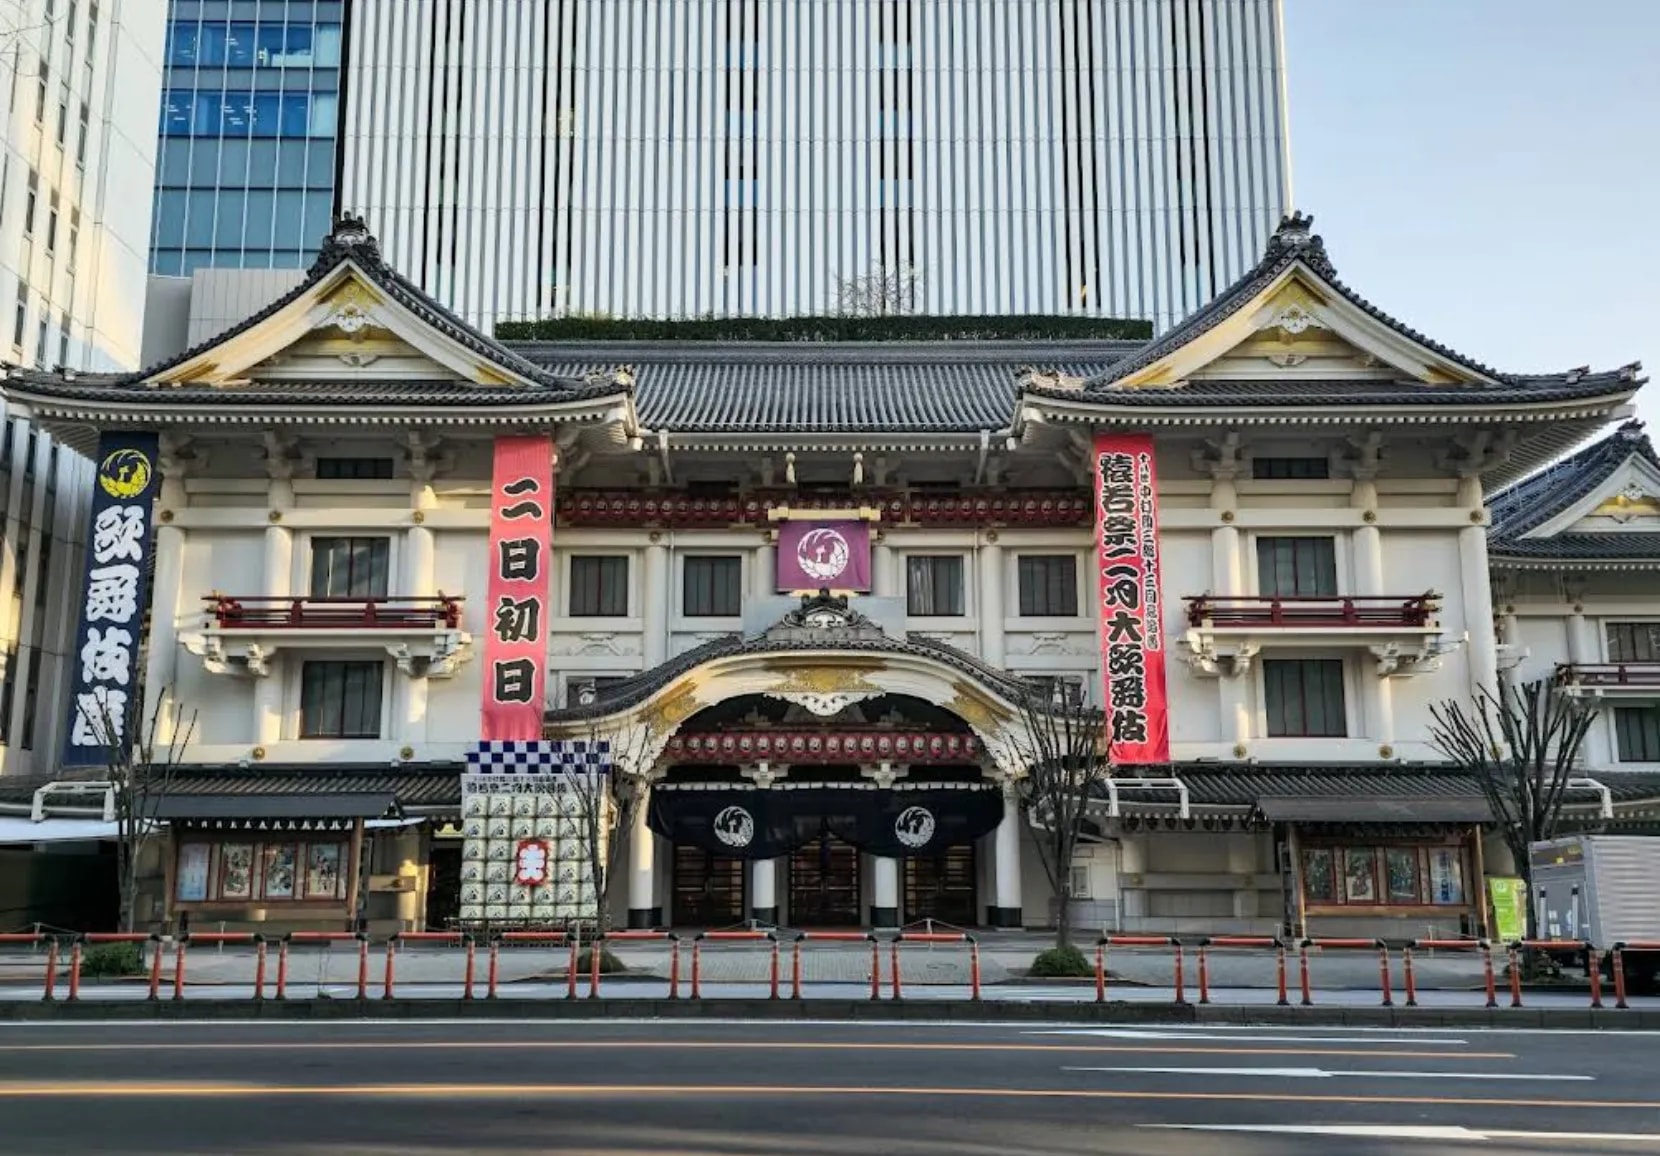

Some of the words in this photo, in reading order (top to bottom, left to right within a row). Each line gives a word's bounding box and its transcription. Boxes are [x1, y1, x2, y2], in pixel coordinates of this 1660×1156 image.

[71, 504, 145, 747] 歌舞伎座
[493, 478, 542, 703] 二日初日
